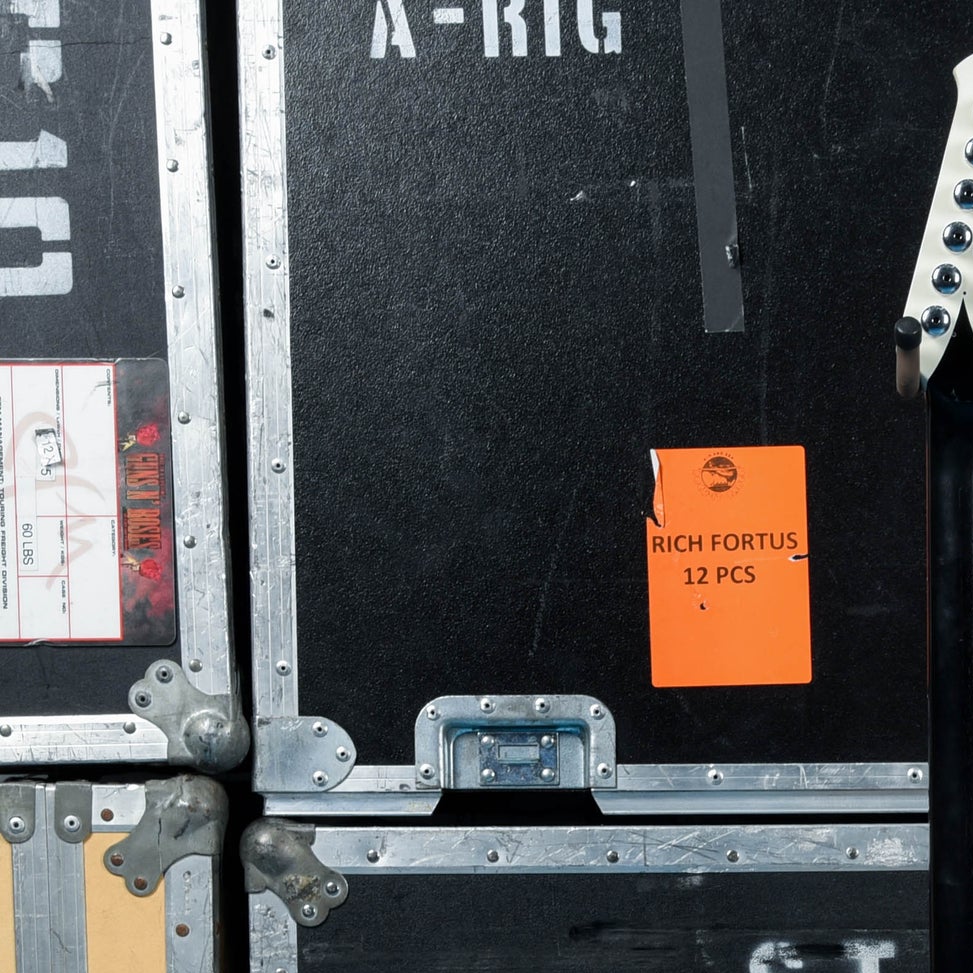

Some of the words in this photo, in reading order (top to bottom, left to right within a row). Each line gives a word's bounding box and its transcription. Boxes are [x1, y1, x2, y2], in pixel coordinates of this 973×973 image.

[21, 523, 33, 538] 60
[127, 508, 162, 550] ROSES
[652, 534, 703, 553] RICH
[711, 532, 798, 551] FORTUS
[22, 541, 34, 566] LBS
[683, 566, 709, 585] 12
[716, 565, 756, 584] PCS
